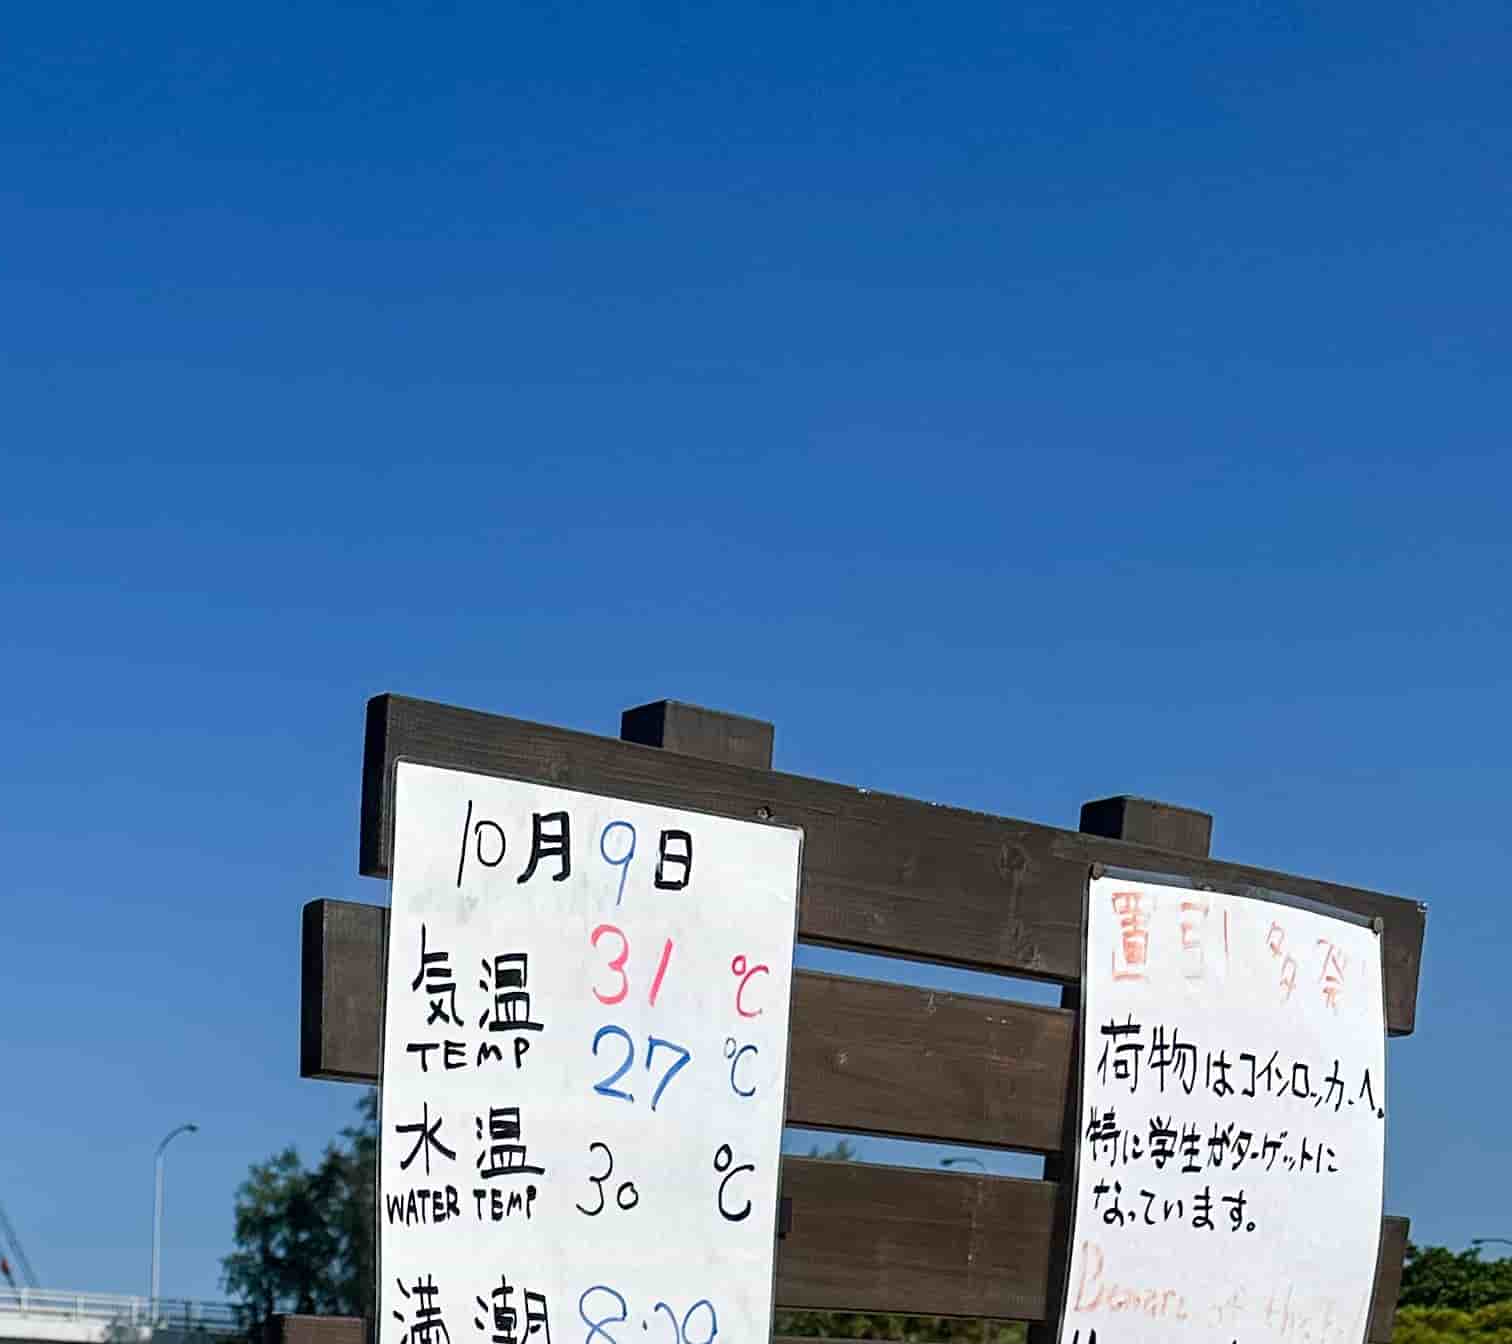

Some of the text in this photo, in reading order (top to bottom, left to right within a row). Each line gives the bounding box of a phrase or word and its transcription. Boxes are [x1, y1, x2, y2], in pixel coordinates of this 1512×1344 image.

[412, 924, 544, 1031] 気温
[591, 925, 673, 1007] 31
[406, 1038, 530, 1072] TEMP
[591, 1025, 690, 1111] 27
[387, 1185, 536, 1226] WATER TEMP
[396, 1102, 545, 1175] 水温
[576, 1143, 639, 1215] 30
